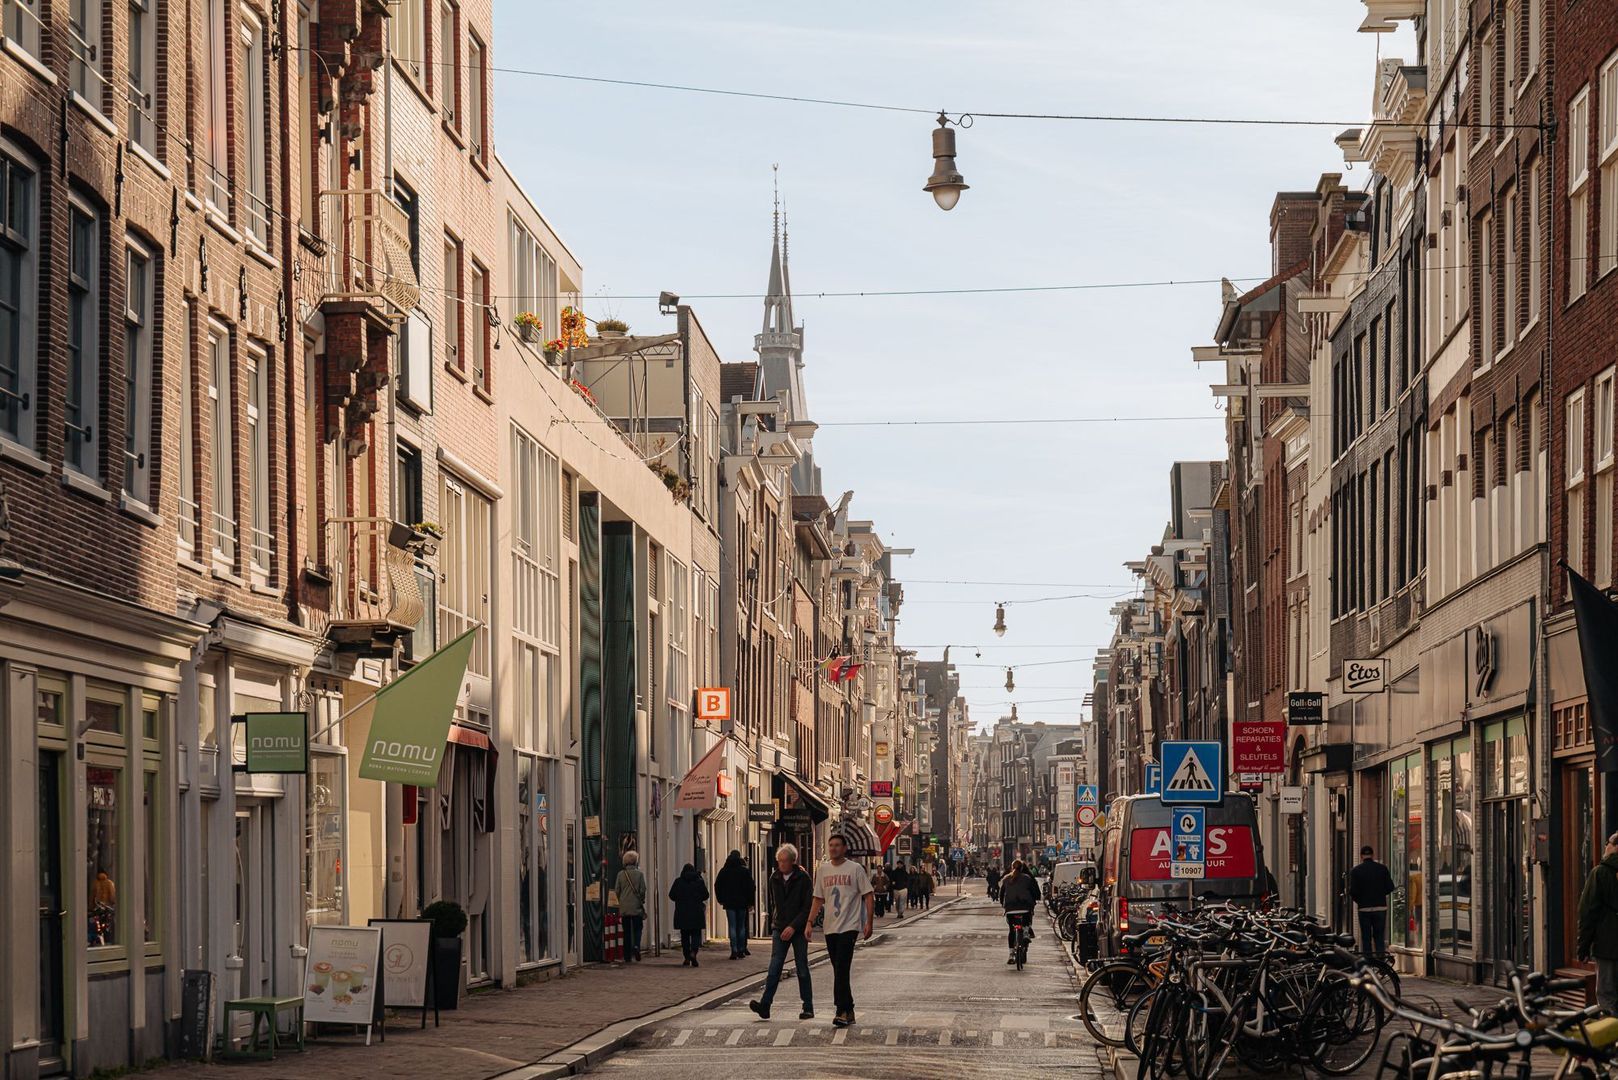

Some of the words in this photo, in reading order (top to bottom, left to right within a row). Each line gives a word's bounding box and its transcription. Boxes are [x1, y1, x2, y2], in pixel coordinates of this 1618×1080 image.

[1348, 663, 1380, 681] Etos
[707, 695, 720, 711] B
[1242, 726, 1274, 734] SCHOEN
[252, 737, 300, 748] nomu
[372, 740, 436, 762] nomu
[1240, 753, 1277, 761] SLEUTELS
[1181, 867, 1202, 875] 10907
